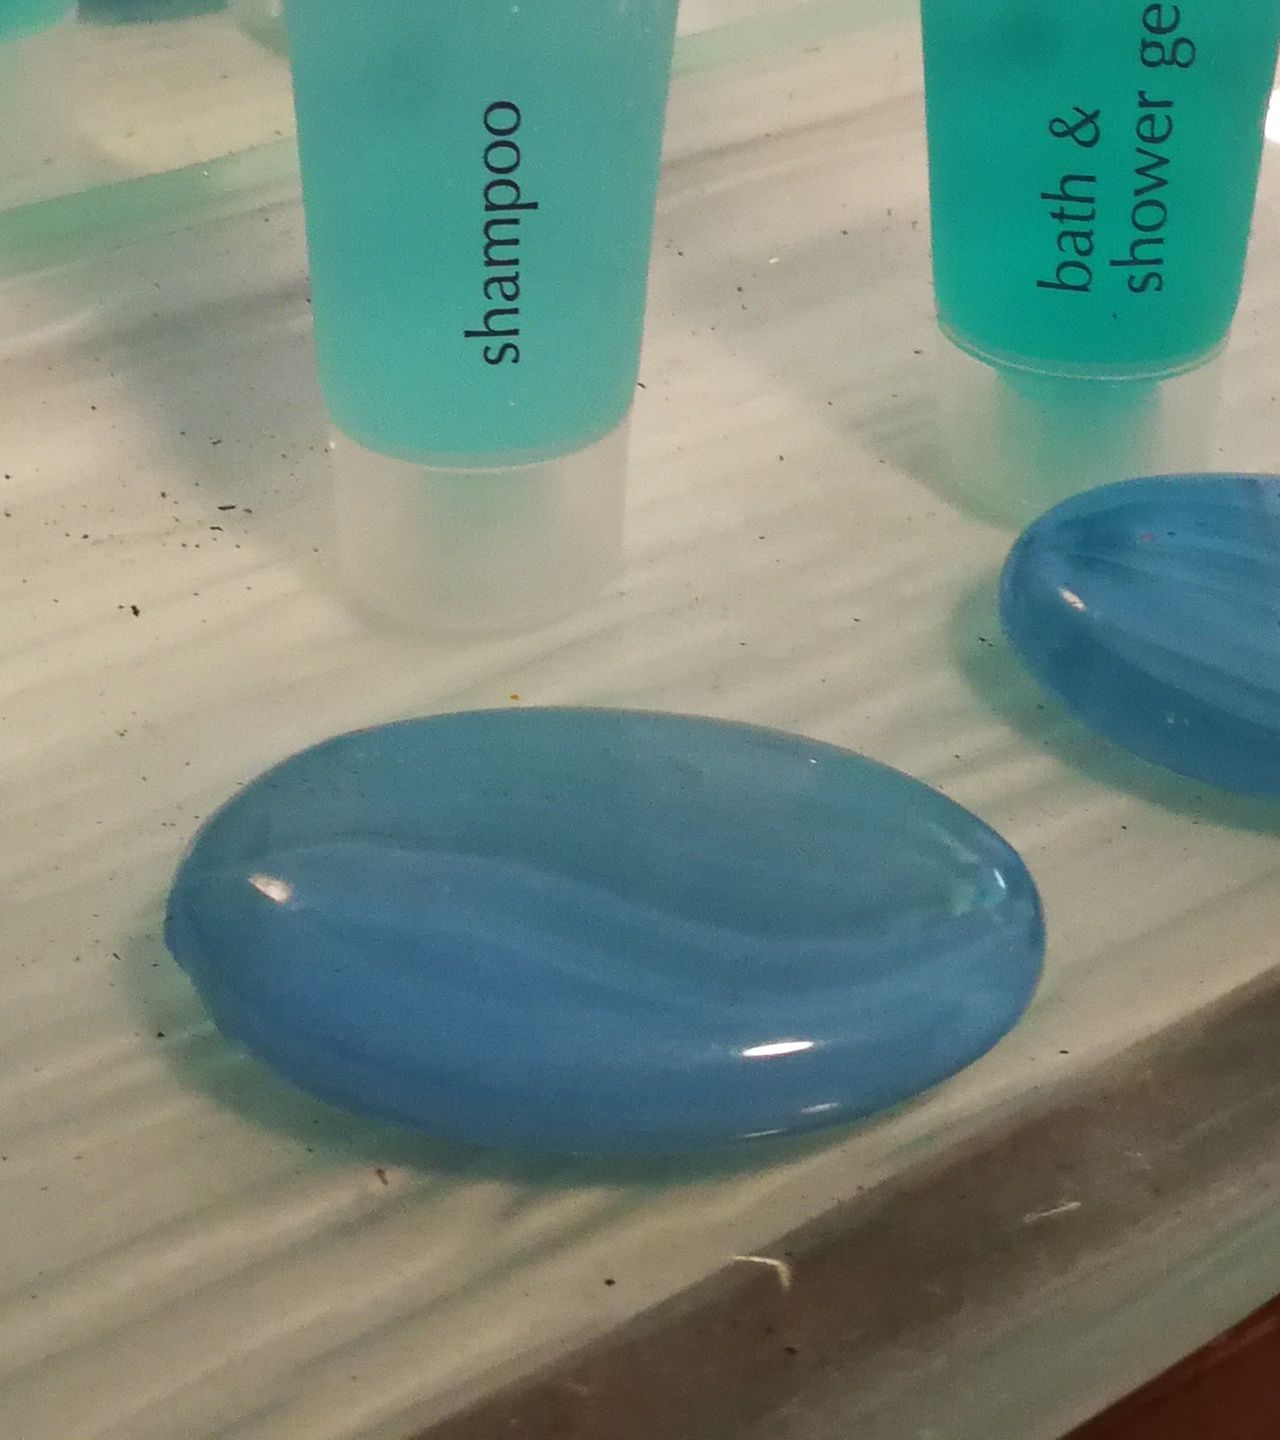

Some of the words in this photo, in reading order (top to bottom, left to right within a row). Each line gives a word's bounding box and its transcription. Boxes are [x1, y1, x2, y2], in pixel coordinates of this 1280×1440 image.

[1049, 106, 1101, 148] &
[1110, 89, 1174, 294] shower
[464, 100, 538, 366] shampoo
[1036, 174, 1097, 294] bath
